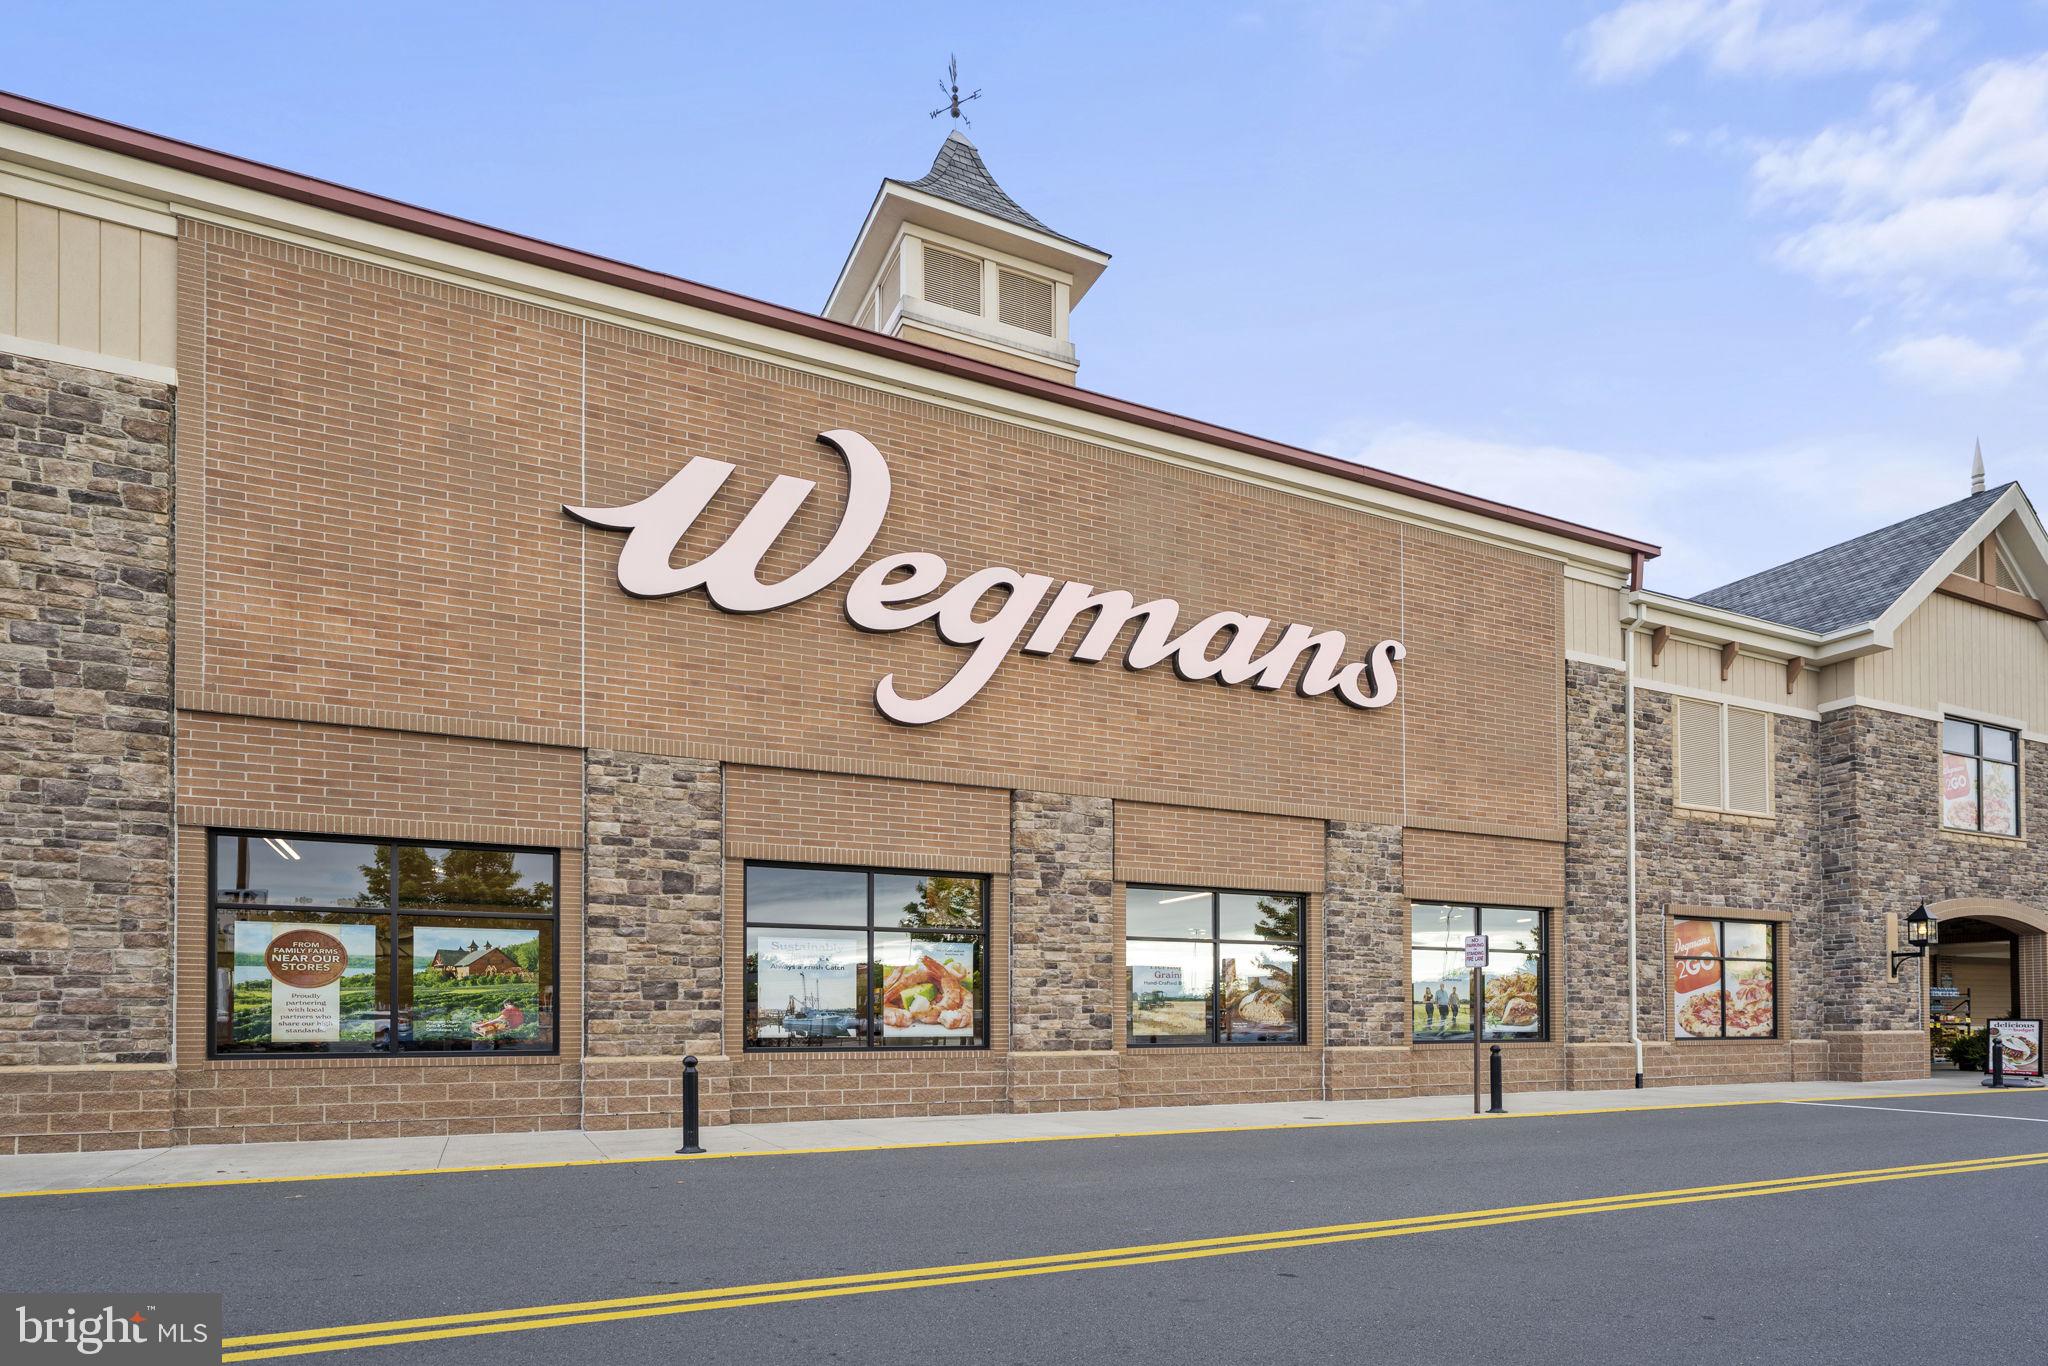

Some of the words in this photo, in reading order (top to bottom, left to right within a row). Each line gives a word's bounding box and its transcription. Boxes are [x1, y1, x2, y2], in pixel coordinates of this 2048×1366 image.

[562, 428, 1406, 726] Wegmans
[770, 941, 844, 953] Sustainably
[271, 954, 308, 962] NEAR
[311, 955, 340, 963] OUR
[281, 963, 330, 971] STORES
[1676, 951, 1715, 980] 2GO
